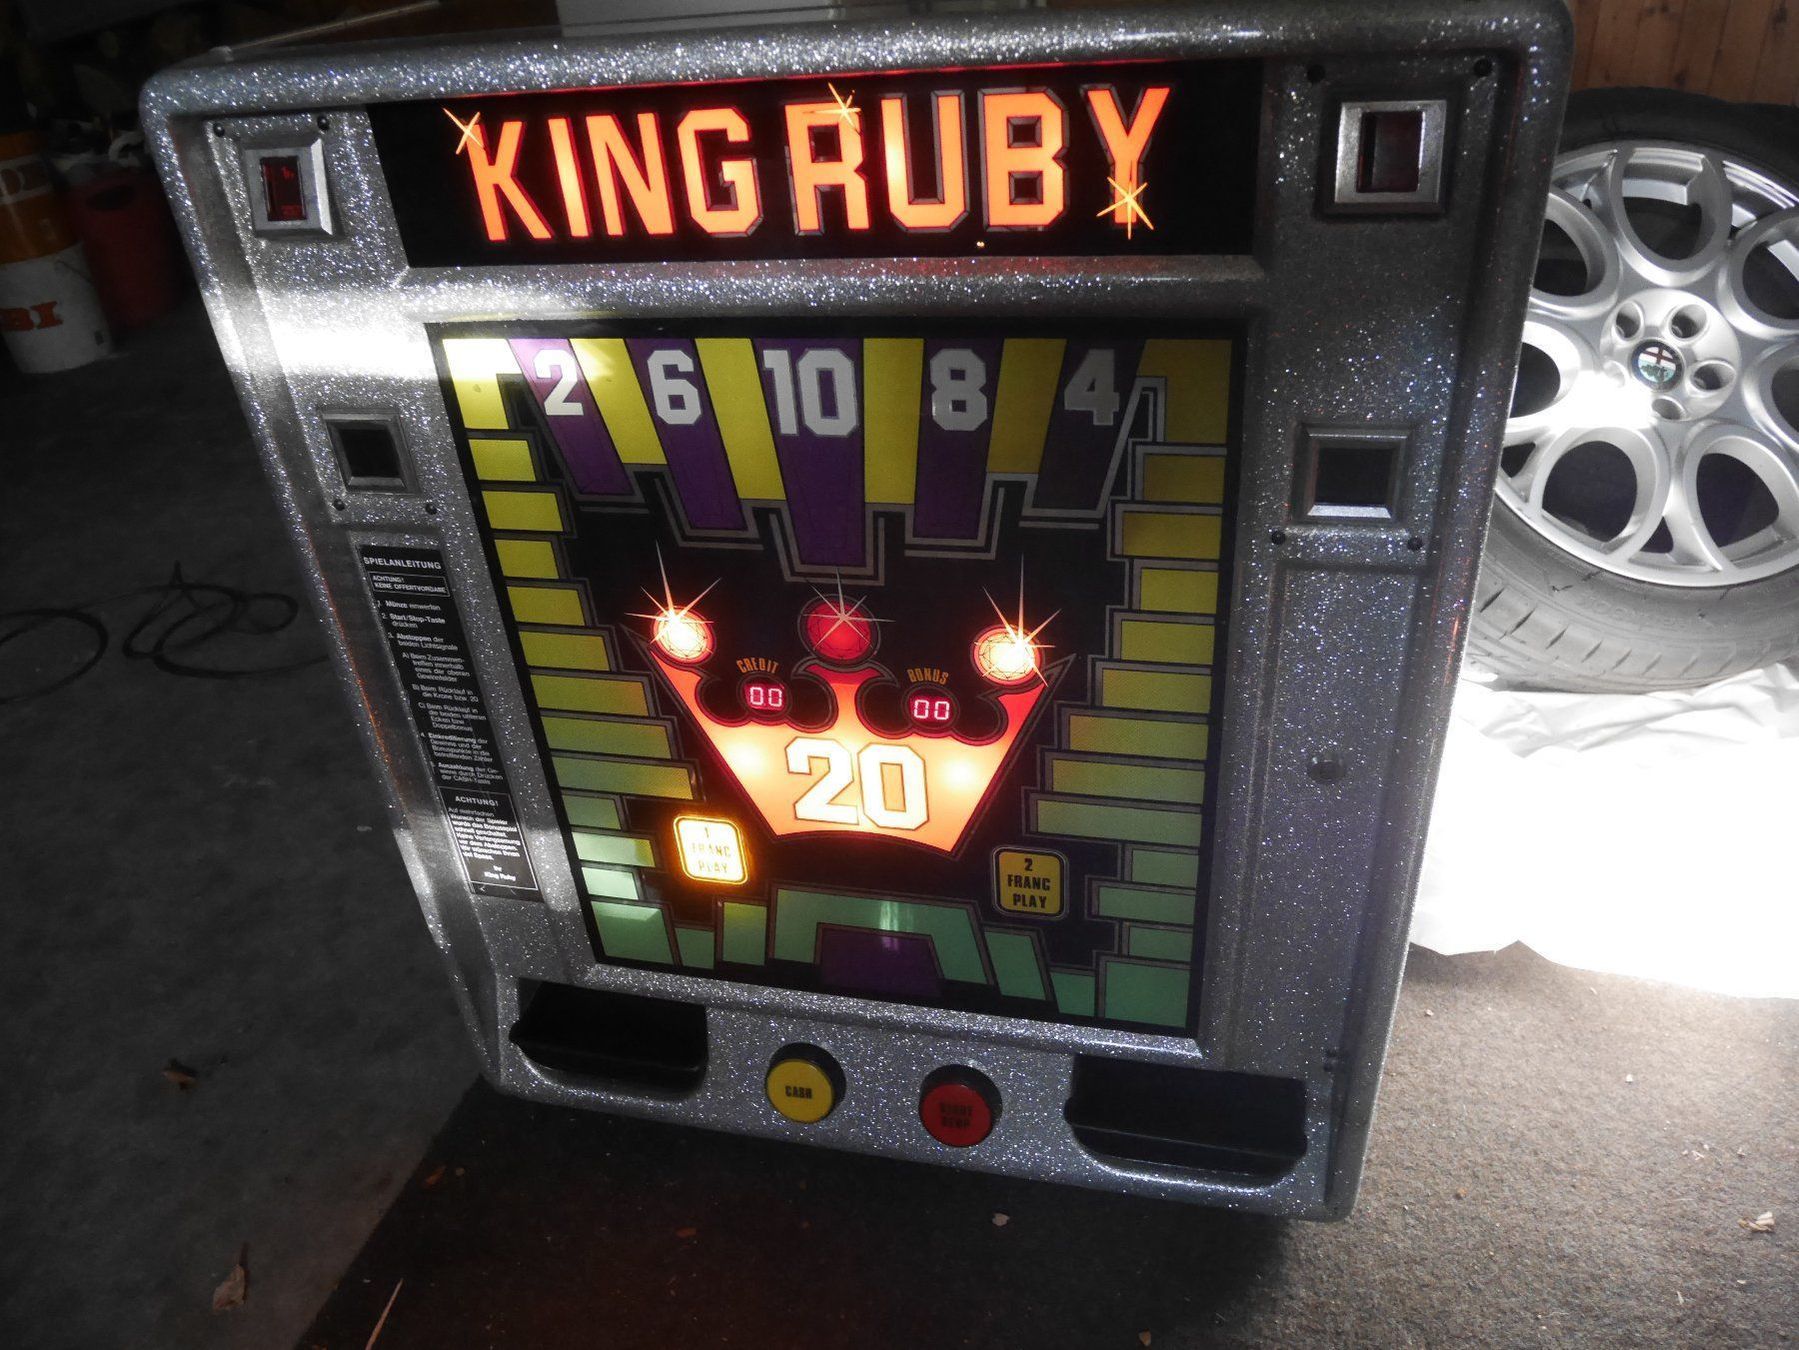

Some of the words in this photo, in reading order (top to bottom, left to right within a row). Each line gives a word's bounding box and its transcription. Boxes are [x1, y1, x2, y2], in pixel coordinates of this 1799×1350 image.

[471, 107, 764, 241] KING
[784, 85, 1170, 235] RUBY
[533, 349, 584, 417] 2
[646, 349, 701, 425] 6
[929, 348, 989, 431] 8
[1063, 349, 1119, 426] 4
[763, 348, 858, 438] 10
[363, 557, 441, 569] SPIELANLEITUNG
[736, 657, 779, 674] CREDIT
[907, 667, 949, 686] BONUS
[914, 699, 950, 720] 00
[784, 737, 929, 831] 20
[455, 796, 498, 806] ACHTUNG!
[698, 860, 728, 873] PLAY
[1024, 857, 1033, 871] 2
[1007, 874, 1051, 891] FRANC
[1012, 893, 1047, 909] PLAY
[785, 1085, 812, 1099] CASH
